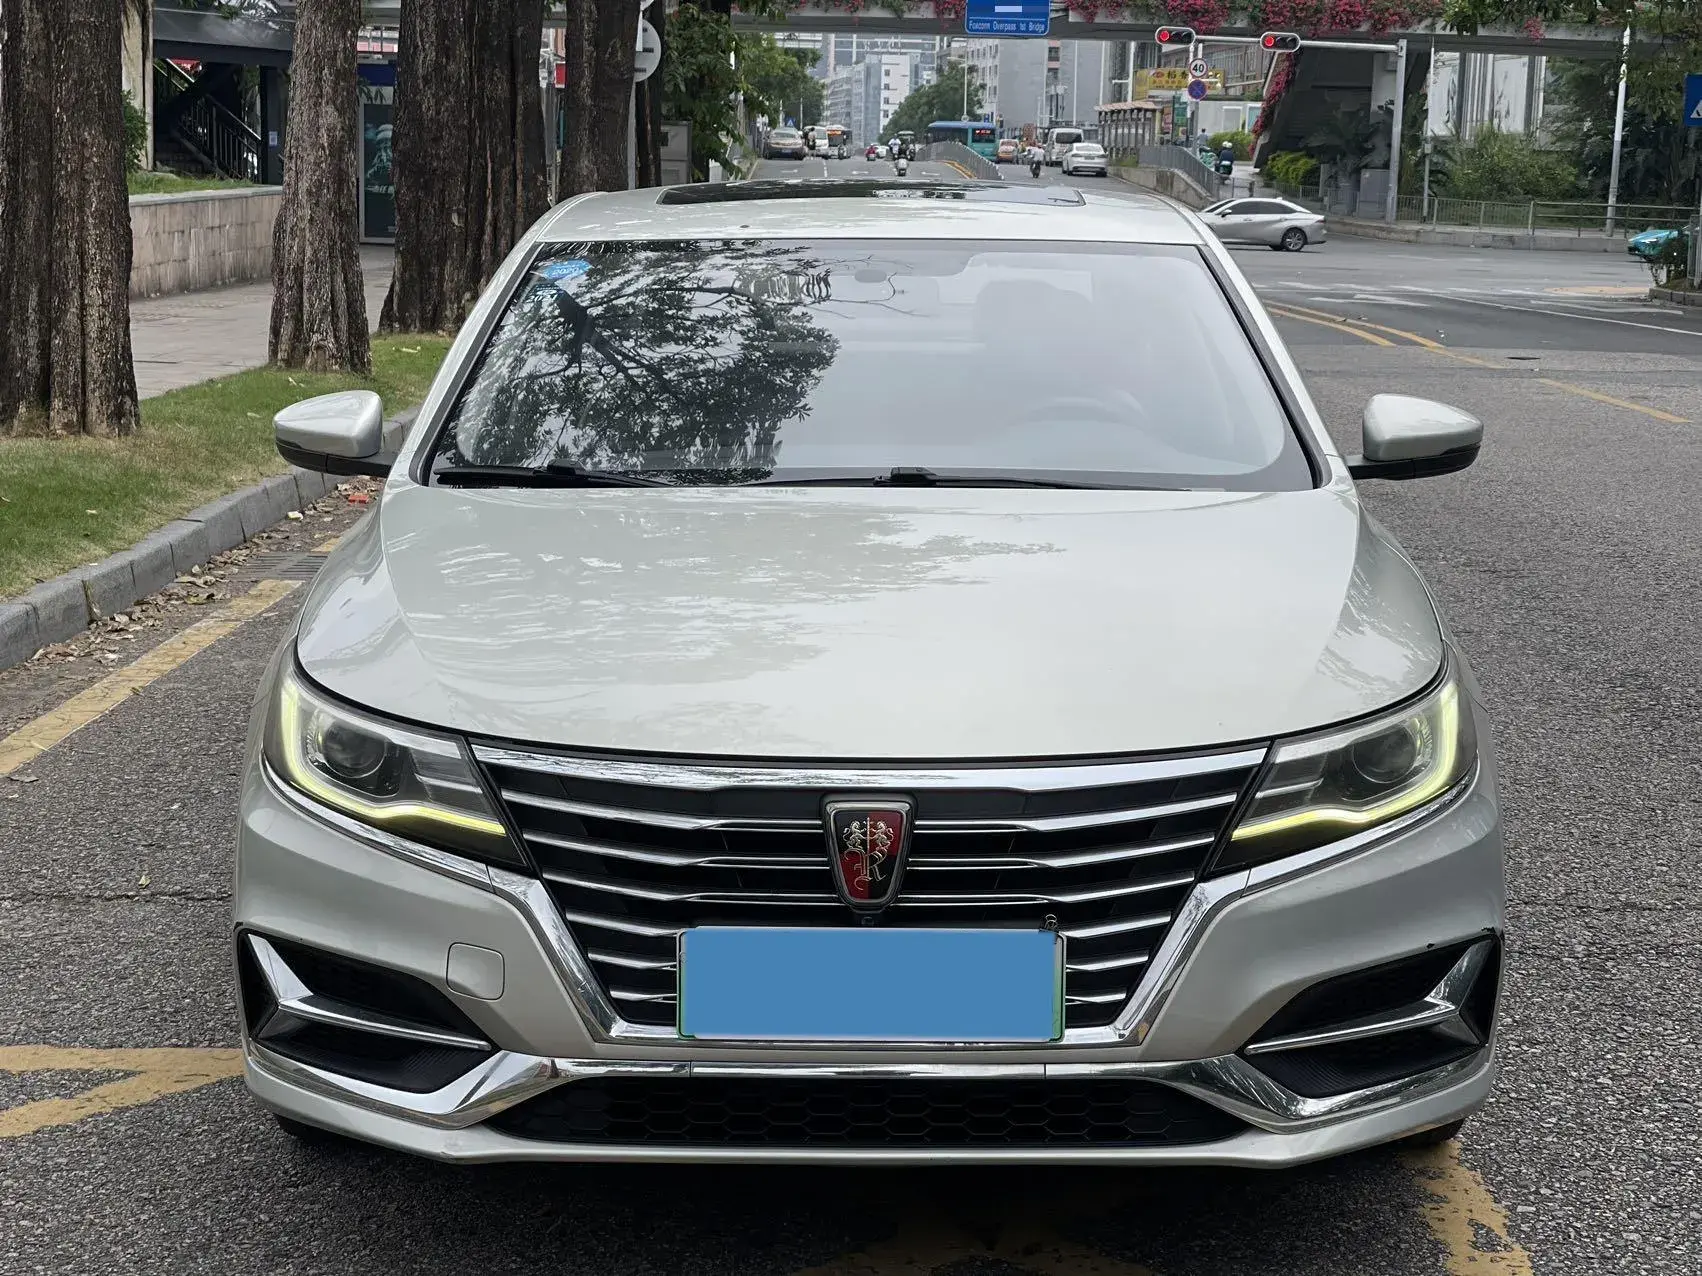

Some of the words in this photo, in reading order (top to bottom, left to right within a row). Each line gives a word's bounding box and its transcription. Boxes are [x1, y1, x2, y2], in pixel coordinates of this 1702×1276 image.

[993, 21, 1017, 32] Overpass
[1028, 21, 1045, 32] Bridge
[1192, 63, 1205, 73] 40
[551, 267, 580, 276] 2020
